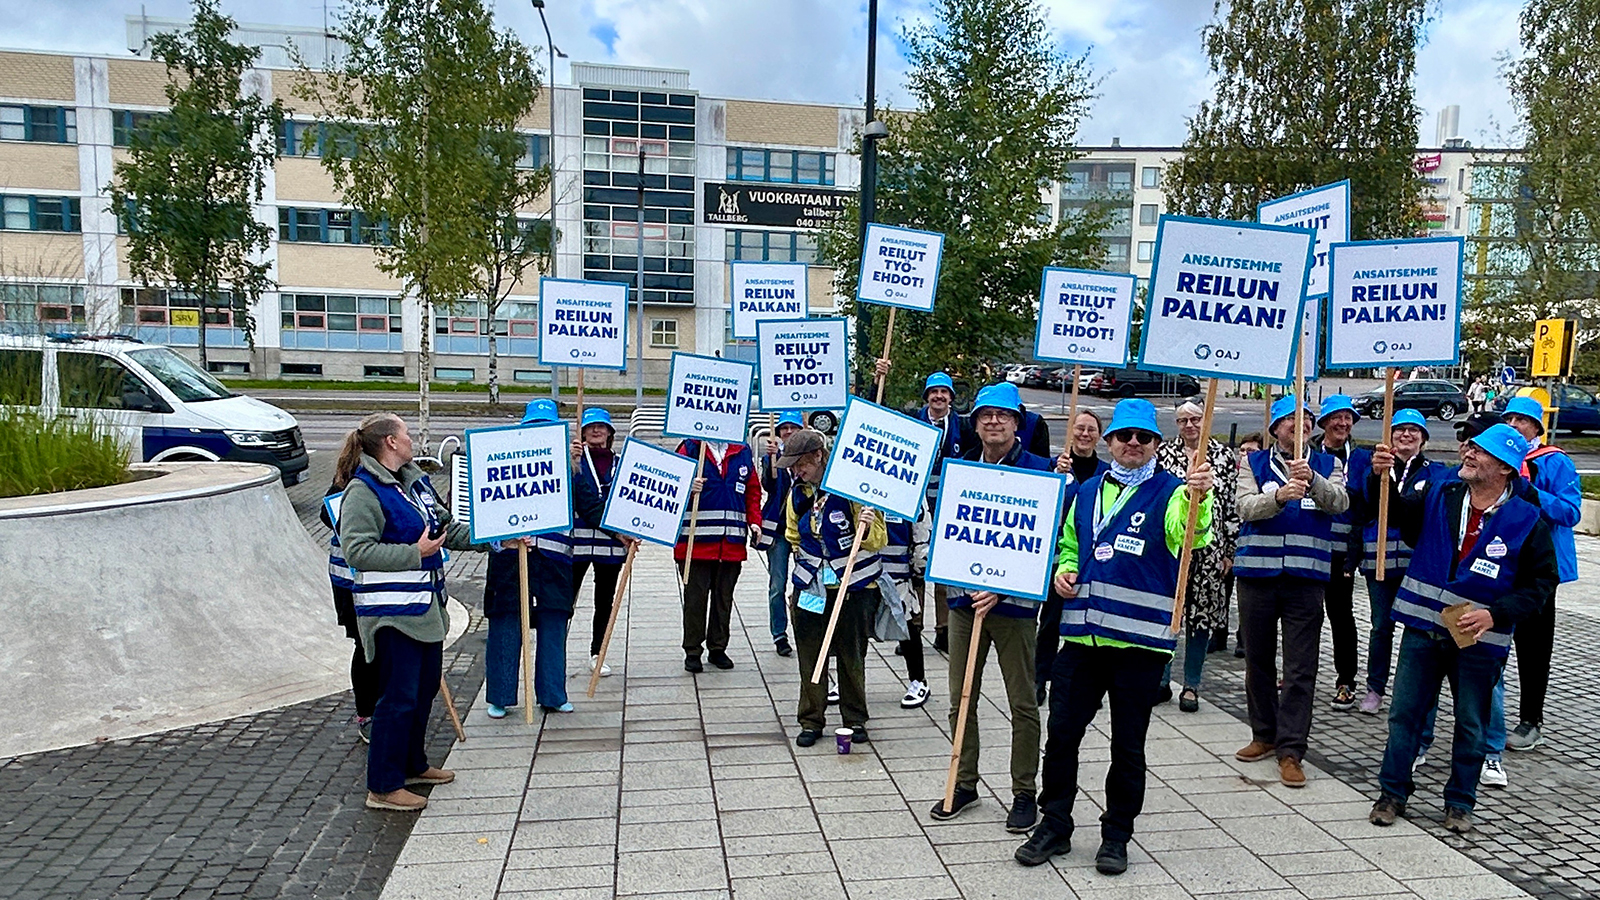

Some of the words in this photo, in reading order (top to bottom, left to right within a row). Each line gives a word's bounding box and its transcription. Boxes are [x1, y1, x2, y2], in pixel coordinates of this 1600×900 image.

[749, 191, 832, 206] VUOKRATAAN
[708, 213, 748, 222] TALLBERG
[1274, 202, 1330, 223] ANSAITSEMME
[796, 218, 813, 227] 040
[879, 246, 926, 262] REILUT
[884, 259, 917, 273] TYÖ-
[1182, 253, 1282, 273] ANSAITSEMME
[873, 271, 924, 288] EHDOT!
[1353, 267, 1437, 279] ANSAITSEMME
[745, 288, 795, 299] REILUN
[1060, 283, 1117, 293] ANSAITSEMME
[1176, 272, 1279, 301] REILUN
[1352, 282, 1437, 302] REILUN
[556, 298, 612, 308] ANSAITSEMME
[739, 301, 801, 312] PALKAN!
[1059, 293, 1116, 309] REILUT
[175, 314, 195, 322] SRV
[555, 309, 612, 323] REILUN
[1066, 307, 1105, 323] TYÖ-
[1161, 297, 1286, 330] PALKAN!
[1341, 304, 1446, 324] PALKAN!
[549, 323, 618, 339] PALKAN!
[775, 332, 830, 340] ANSAITSEMME
[1053, 323, 1114, 341] EHDOT!
[1540, 324, 1549, 341] P
[775, 342, 830, 355] REILUT
[1215, 349, 1240, 360] OAJ
[1391, 343, 1412, 351] OAJ
[783, 354, 822, 370] TYÖ-
[685, 373, 738, 385] ANSAITSEMME
[774, 373, 833, 386] EHDOT!
[683, 382, 737, 400] REILUN
[676, 396, 742, 415] PALKAN!
[859, 423, 920, 450] ANSAITSEMME
[487, 447, 552, 462] ANSAITSEMME
[854, 433, 917, 467] REILUN
[487, 460, 553, 482] REILUN
[633, 462, 681, 482] ANSAITSEMME
[842, 447, 919, 486] PALKAN!
[481, 478, 561, 502] PALKAN!
[628, 472, 678, 498] REILUN
[872, 488, 888, 498] OAJ
[618, 486, 679, 515] PALKAN!
[960, 489, 1039, 508] ANSAITSEMME
[522, 514, 538, 522] OAJ
[642, 521, 655, 529] OAJ
[956, 504, 1036, 531] REILUN
[944, 523, 1042, 554] PALKAN!
[986, 568, 1006, 577] OAJ
